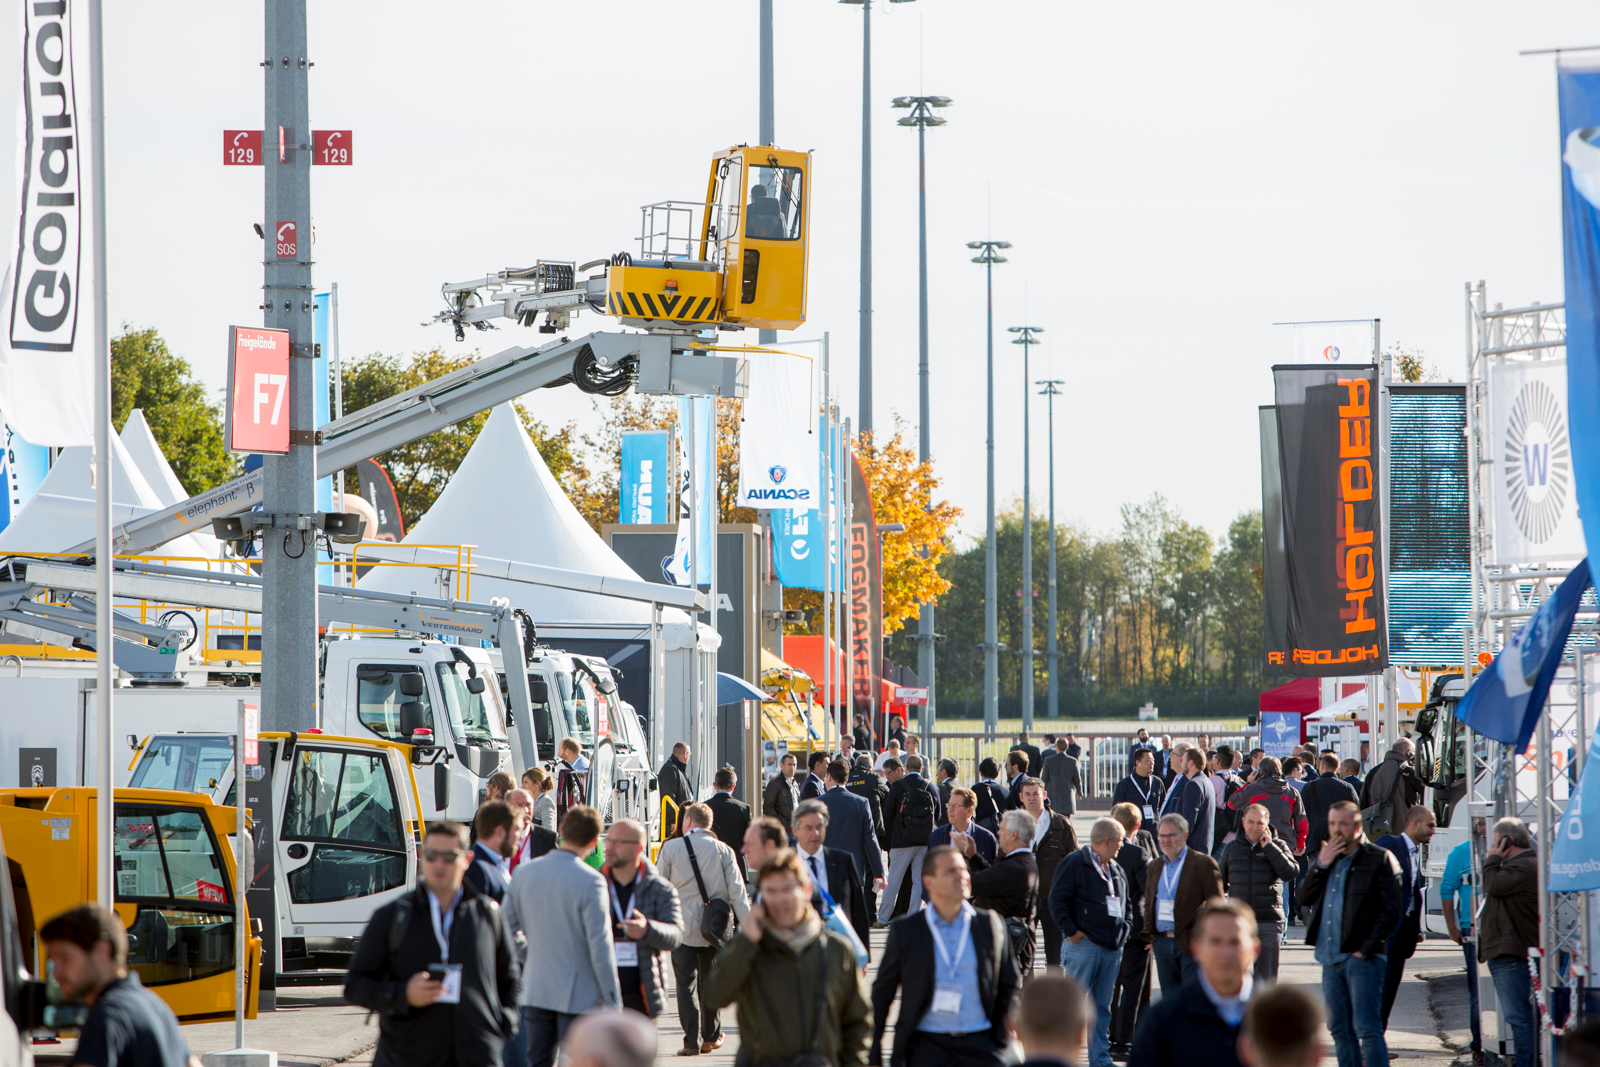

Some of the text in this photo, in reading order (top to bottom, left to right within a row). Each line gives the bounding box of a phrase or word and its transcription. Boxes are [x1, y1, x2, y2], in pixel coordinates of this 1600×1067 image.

[228, 148, 255, 163] 129
[322, 148, 348, 163] 129
[276, 243, 296, 255] SOS
[238, 333, 276, 352] Freigelände
[253, 373, 288, 425] F7
[1523, 443, 1549, 487] W
[185, 473, 258, 507] VESTERGAARD DE-ICING SYSTEM
[851, 522, 872, 700] FOGMAKER
[421, 620, 483, 634] VESTERGAARD
